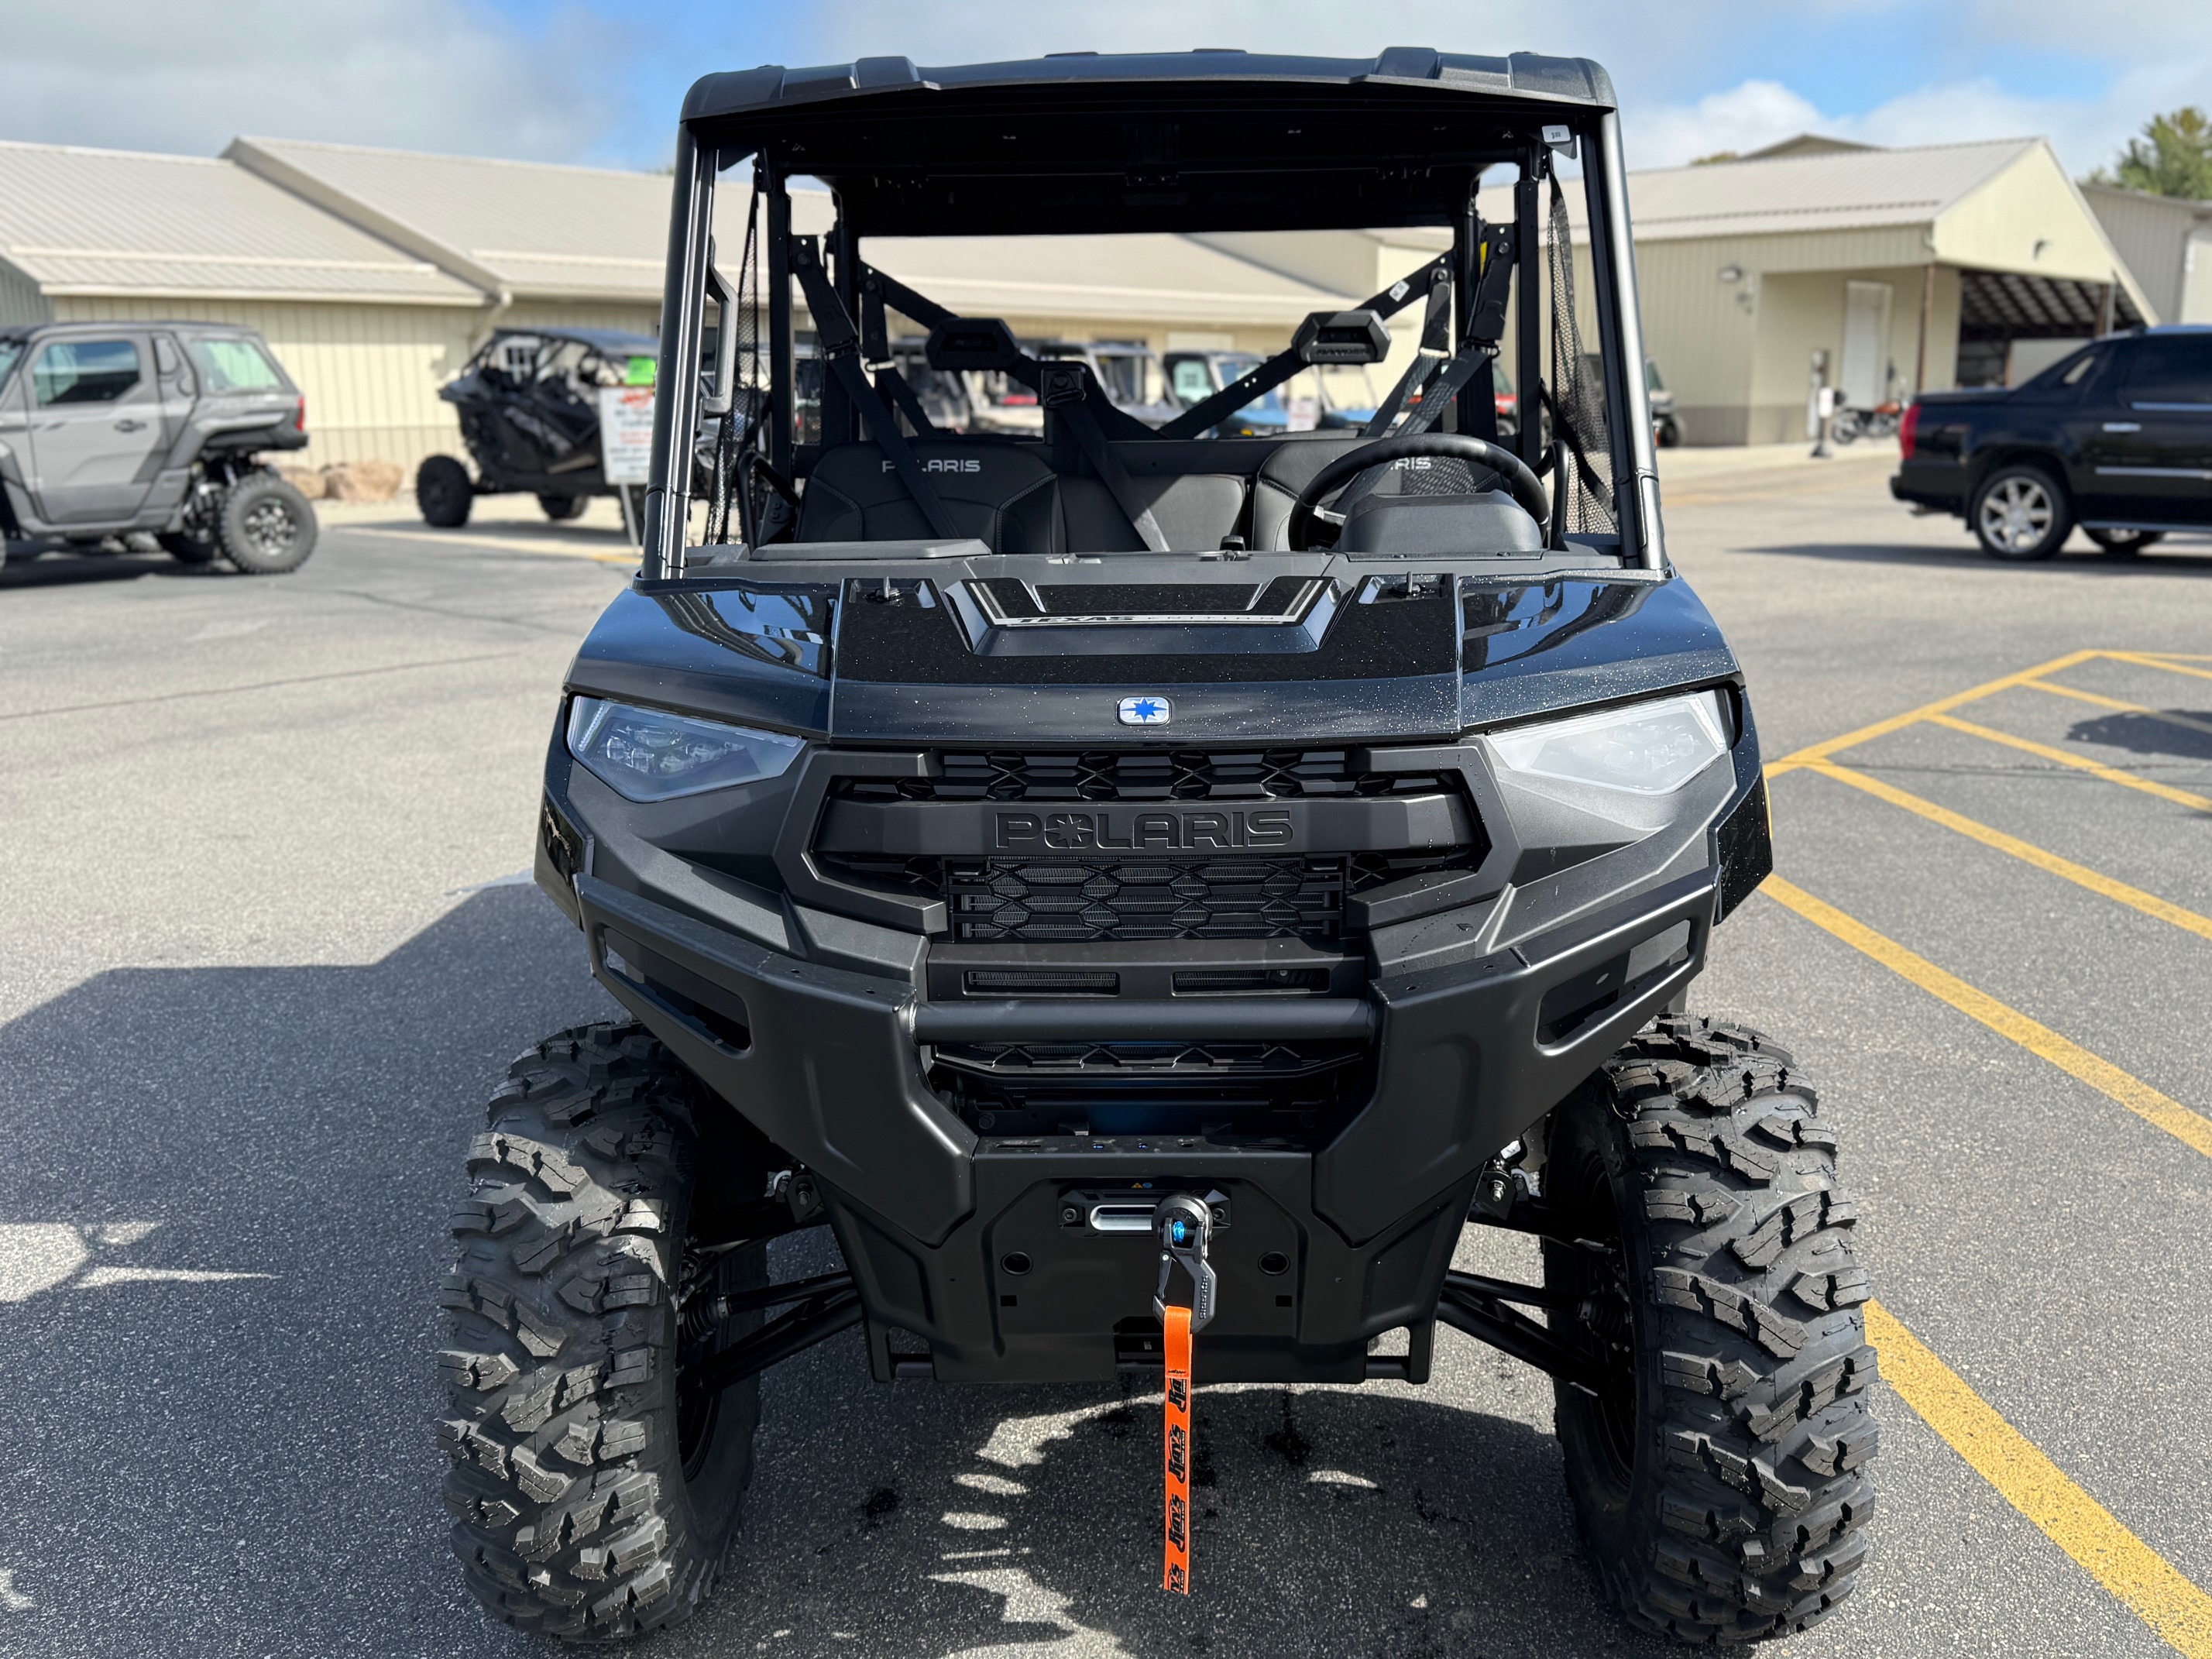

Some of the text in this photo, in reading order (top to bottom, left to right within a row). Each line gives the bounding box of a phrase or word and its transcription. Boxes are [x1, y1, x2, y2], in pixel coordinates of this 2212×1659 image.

[881, 459, 981, 472] PARIS
[995, 810, 1294, 850] POLARIS
[1200, 1275, 1208, 1319] POLARIS
